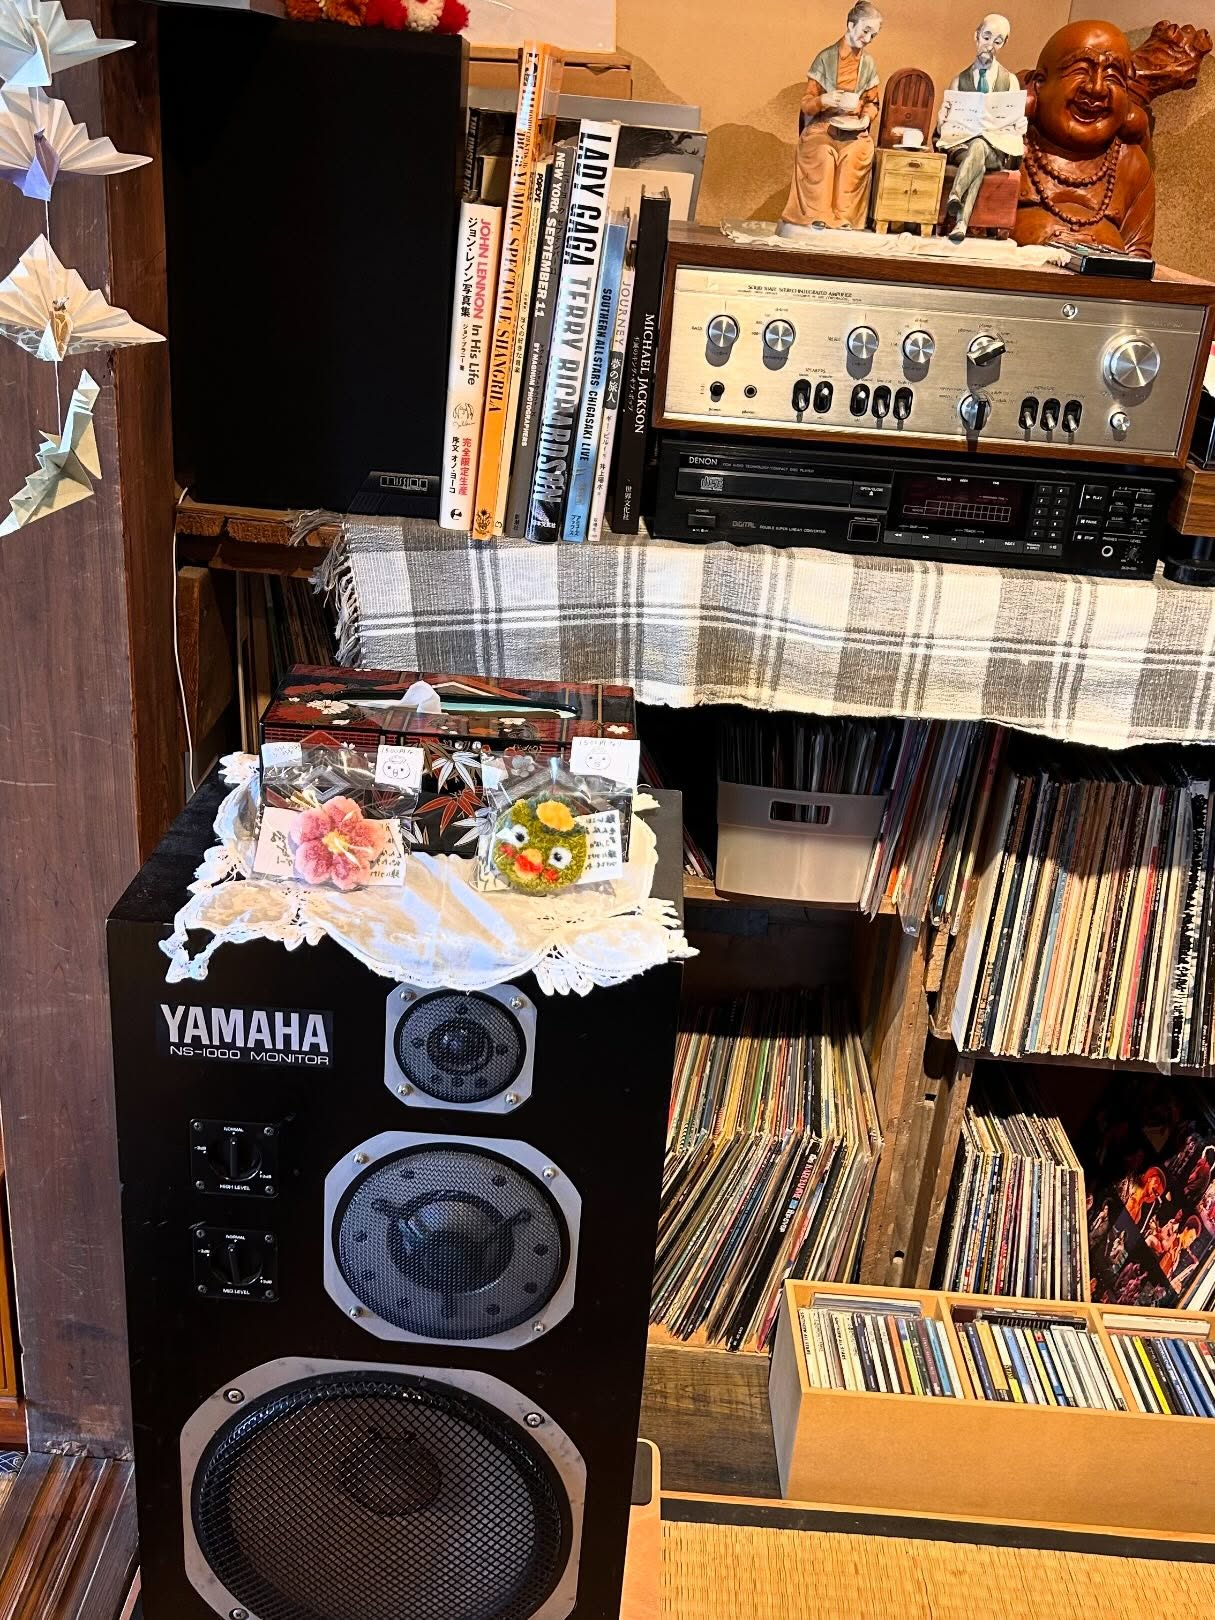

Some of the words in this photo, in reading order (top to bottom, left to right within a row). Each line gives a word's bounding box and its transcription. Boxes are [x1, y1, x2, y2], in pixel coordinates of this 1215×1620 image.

[534, 173, 543, 203] POPEYE
[555, 152, 565, 180] NEW
[574, 132, 612, 198] LADY
[509, 172, 527, 231] YUMING
[548, 182, 562, 213] YORK
[478, 219, 491, 258] JOHN
[537, 218, 556, 300] SEPTEMBER
[564, 203, 601, 265] GAGA
[460, 217, 478, 317] ジョン・レノン写真集
[473, 262, 488, 319] LENNON
[497, 239, 520, 325] SPECTACLE
[472, 324, 482, 336] In
[534, 301, 546, 317] 11
[553, 277, 592, 352] TERRY
[597, 288, 612, 338] SOUTHERN
[615, 281, 631, 346] JOURNEY
[469, 339, 481, 359] His
[639, 313, 655, 372] MICHAEL
[467, 362, 479, 385] Life
[489, 328, 510, 412] SHANGRILA
[528, 352, 539, 386] MAGNUM
[590, 358, 603, 386] STARS
[606, 358, 621, 403] 夢の旅人
[521, 387, 534, 447] PHOTOGRAPHERS
[533, 356, 582, 502] RICHARDSON
[583, 390, 598, 440] CHIGASAKI
[635, 376, 649, 434] JACKSON
[451, 436, 460, 452] 序文
[458, 438, 472, 496] 完全限定生産
[580, 442, 591, 461] LIVE
[689, 456, 718, 465] DENON
[449, 455, 458, 494] オノ・ヨーコ
[732, 520, 756, 528] DIGITAL
[160, 1003, 329, 1053] YAMAHA
[169, 1045, 241, 1059] NS-1000
[250, 1051, 329, 1065] MONITOR
